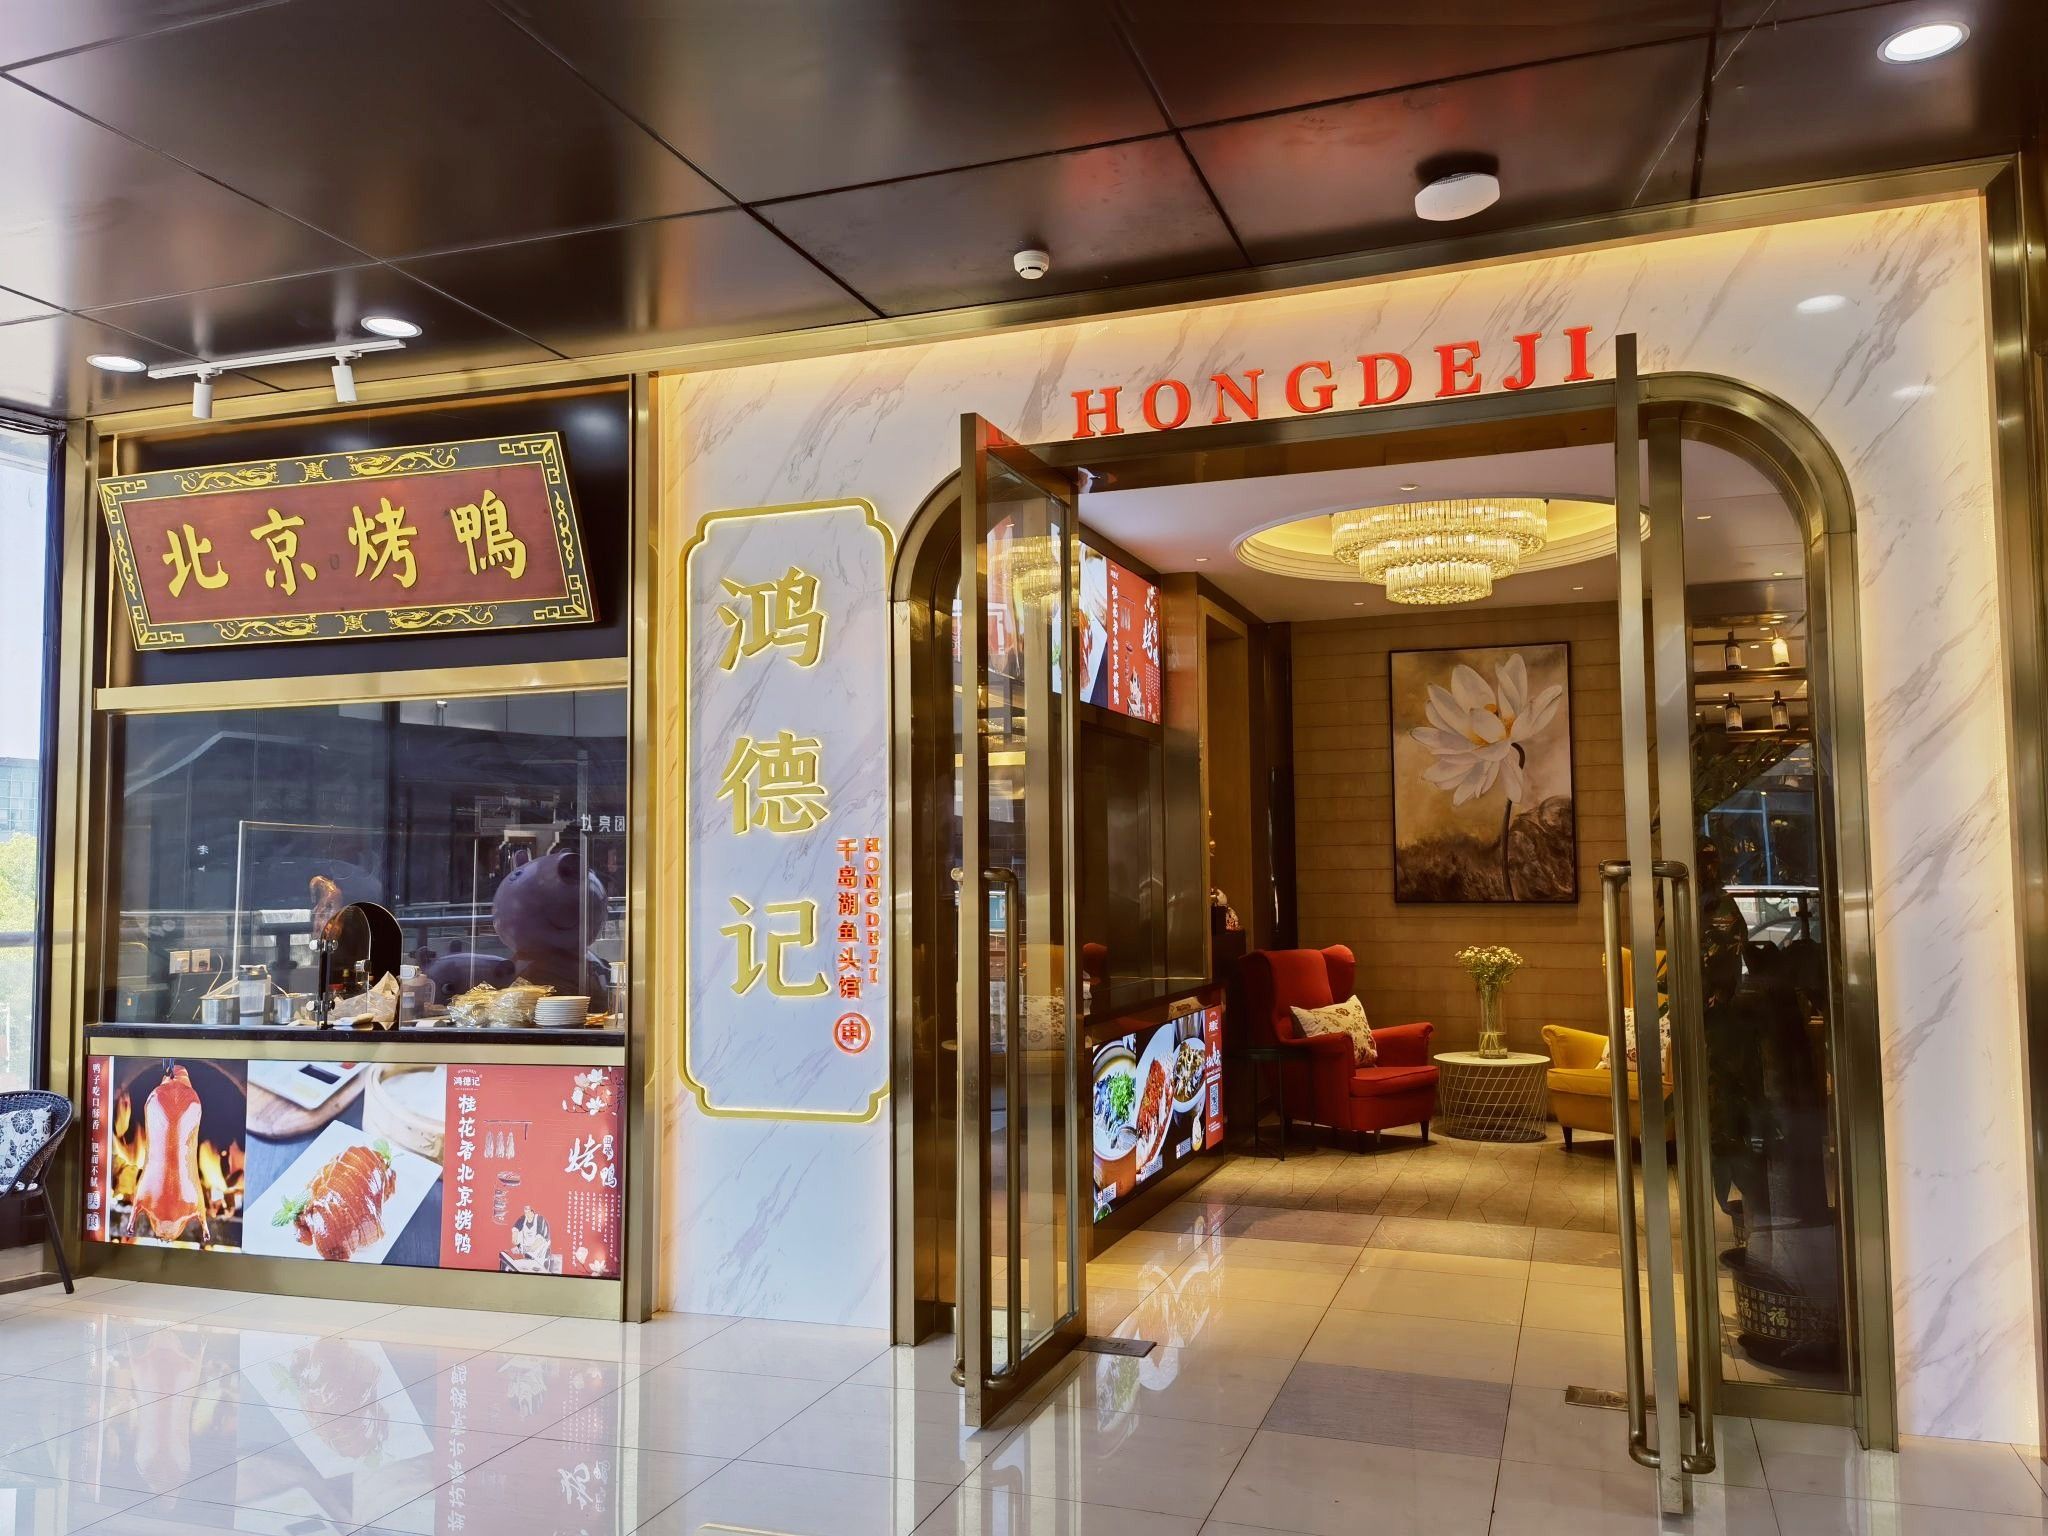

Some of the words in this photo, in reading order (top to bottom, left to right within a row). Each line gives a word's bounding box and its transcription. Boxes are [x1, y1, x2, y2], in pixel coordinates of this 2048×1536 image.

[1071, 325, 1594, 439] HONGDEJI
[715, 565, 831, 997] 鸿德记
[836, 838, 863, 999] 千岛湖鱼头馆
[863, 838, 880, 983] HONGDEJI
[454, 1094, 477, 1254] 桂花香北京烤鸭
[1767, 1306, 1789, 1328] 福
